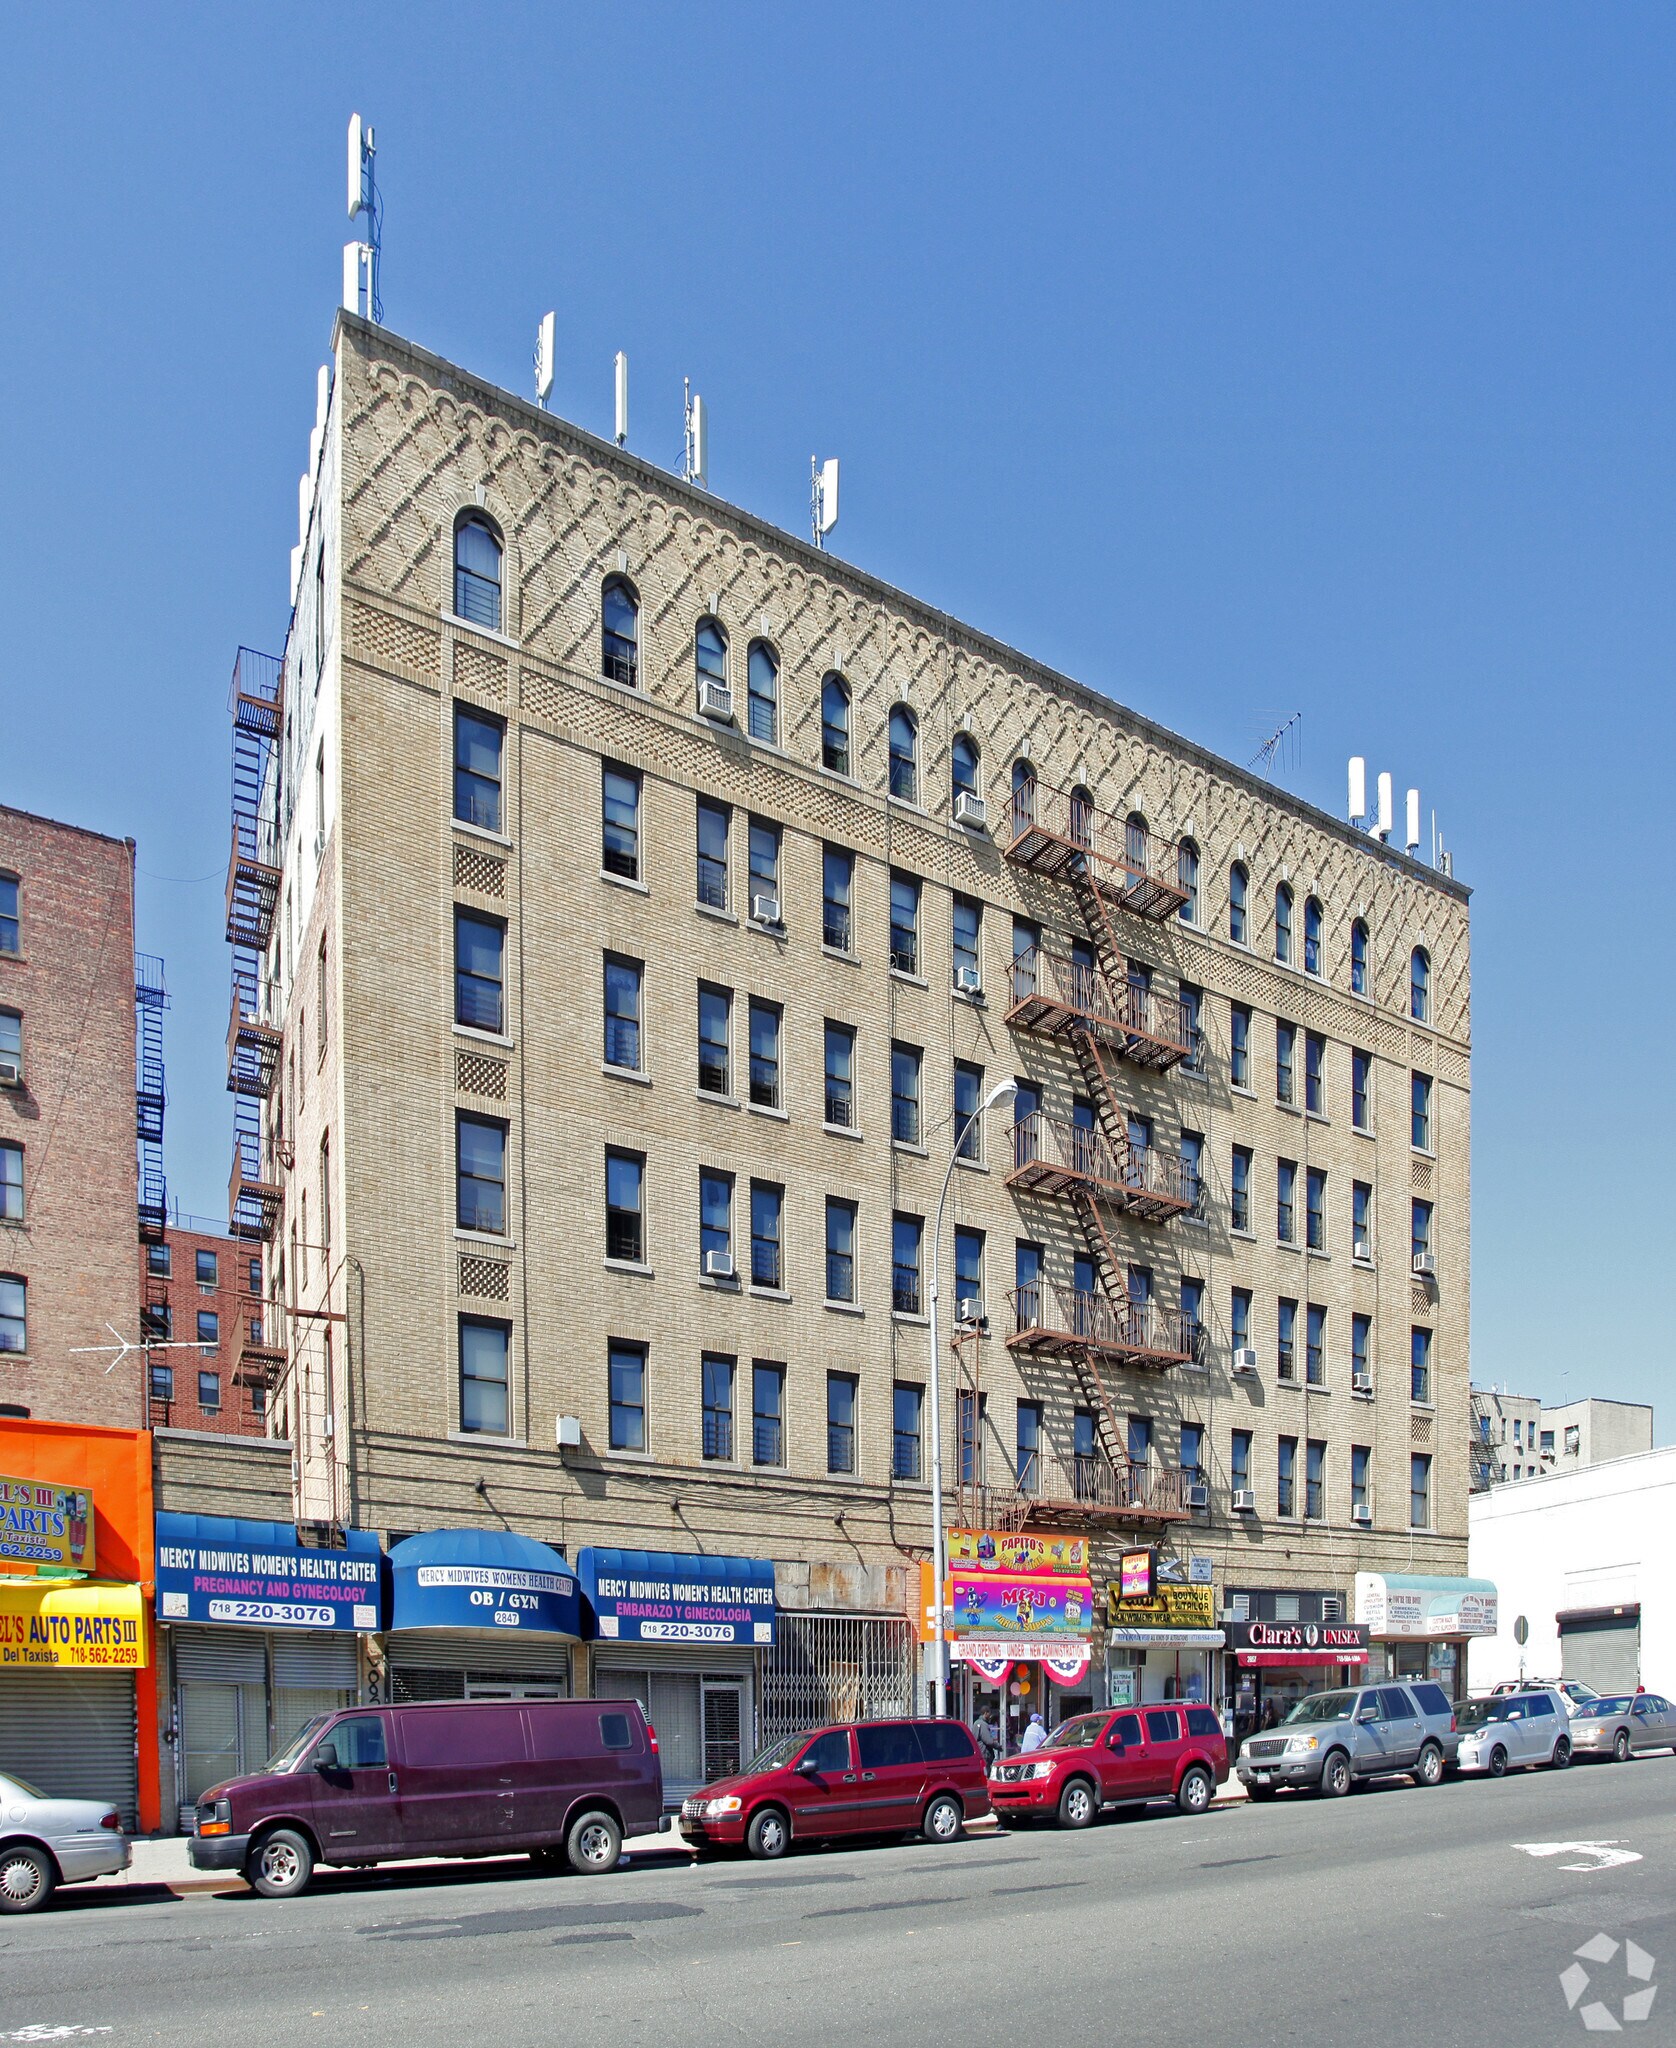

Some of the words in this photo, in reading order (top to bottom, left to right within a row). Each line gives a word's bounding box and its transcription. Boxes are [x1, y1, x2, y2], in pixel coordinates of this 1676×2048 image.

[34, 1487, 54, 1507] III
[6, 1532, 47, 1547] Taxista
[1001, 1537, 1044, 1554] PAPITO'S
[160, 1547, 196, 1569] MERCY
[199, 1550, 249, 1574] MIDWIVES
[252, 1554, 297, 1577] WOMEN'S
[300, 1558, 337, 1580] HEALTH
[340, 1561, 376, 1582] CENTER
[193, 1576, 264, 1596] PREGNANCY
[266, 1581, 290, 1597] AND
[292, 1583, 367, 1602] GYNECOLOGY
[420, 1569, 445, 1582] MERCY
[447, 1570, 489, 1584] MIDWIVES
[492, 1572, 527, 1586] WOMENS
[528, 1575, 555, 1589] HEALTH
[555, 1579, 573, 1593] CENTER
[470, 1591, 494, 1606] OB
[499, 1592, 505, 1607] /
[508, 1594, 539, 1609] GYN
[598, 1578, 628, 1598] MERCY
[629, 1581, 670, 1601] MIDWIVES
[672, 1583, 709, 1602] WOMEN'S
[711, 1586, 741, 1604] HEALTH
[743, 1587, 773, 1605] CENTER
[1001, 1588, 1046, 1607] M&J
[1172, 1591, 1209, 1601] BOUTIQUE
[211, 1603, 231, 1613] 718
[235, 1603, 331, 1622] 220-3076
[496, 1612, 517, 1624] 2847
[616, 1602, 673, 1617] EMBARAZO
[675, 1605, 683, 1619] Y
[684, 1606, 752, 1622] GINECOLOGIA
[29, 1616, 70, 1644] AUTO
[75, 1617, 121, 1644] PARTS
[123, 1620, 137, 1642] III
[643, 1625, 657, 1634] 718
[660, 1624, 731, 1638] 220-3076
[993, 1613, 1021, 1631] PARTY
[1023, 1615, 1055, 1632] SUPPLY
[1249, 1624, 1302, 1645] Clara's
[1323, 1629, 1360, 1644] UNISEX
[3, 1648, 20, 1662] Del
[22, 1648, 59, 1663] Taxista
[958, 1644, 977, 1657] GRAND
[977, 1644, 1001, 1657] OPENING
[1007, 1644, 1025, 1657] UNDER
[1030, 1644, 1041, 1657] NEW
[1042, 1645, 1084, 1658] ADMINISTRATION
